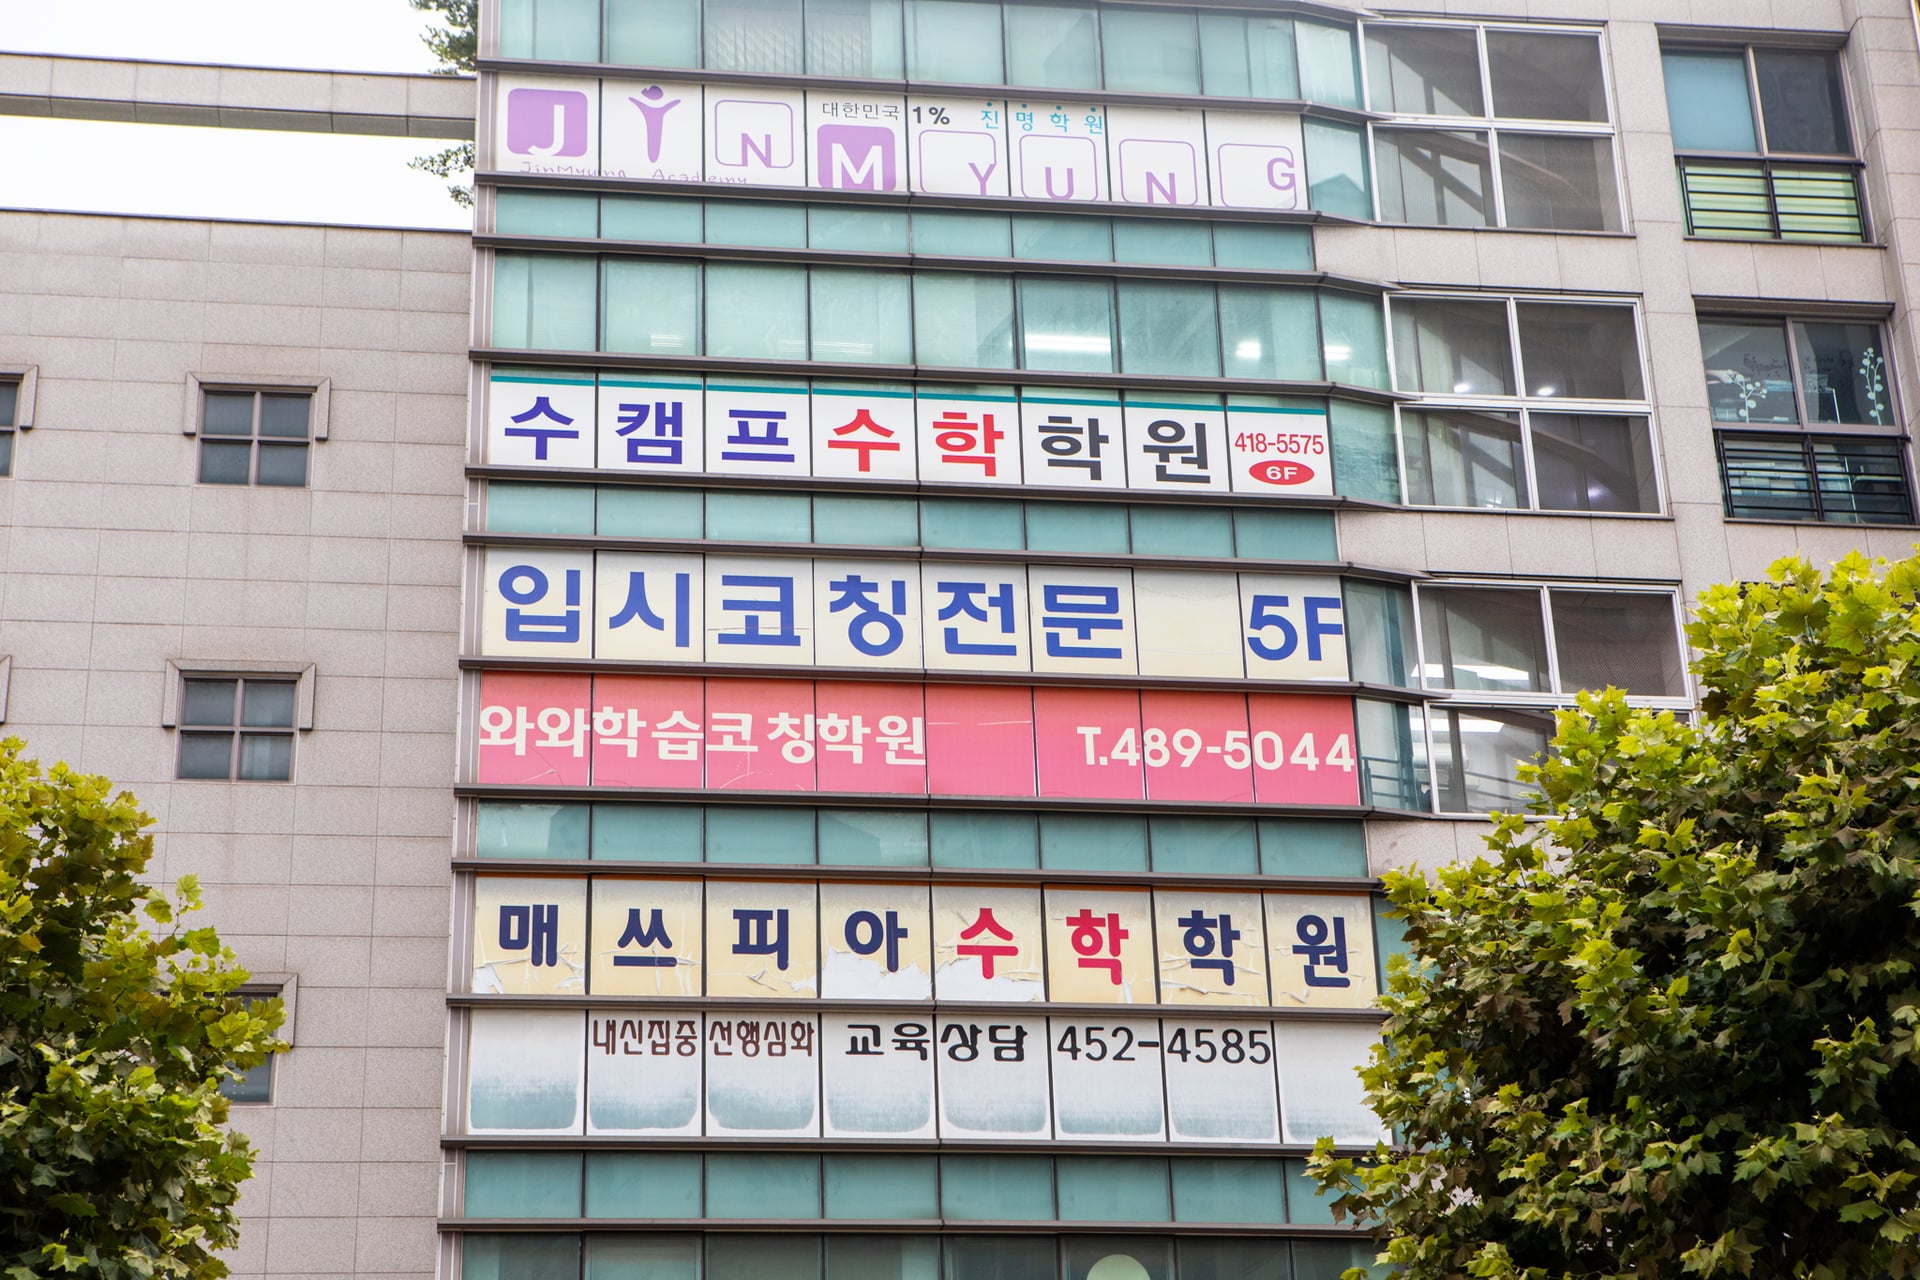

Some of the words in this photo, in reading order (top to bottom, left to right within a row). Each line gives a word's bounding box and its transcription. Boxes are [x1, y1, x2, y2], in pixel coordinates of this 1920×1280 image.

[822, 101, 900, 121] 대한민국
[912, 106, 951, 126] 1%
[1235, 432, 1325, 456] 418-5575
[1265, 466, 1298, 481] 6F
[1247, 594, 1343, 662] 5F
[1076, 726, 1356, 772] T.489-5044
[1056, 1025, 1272, 1065] 452-4585
